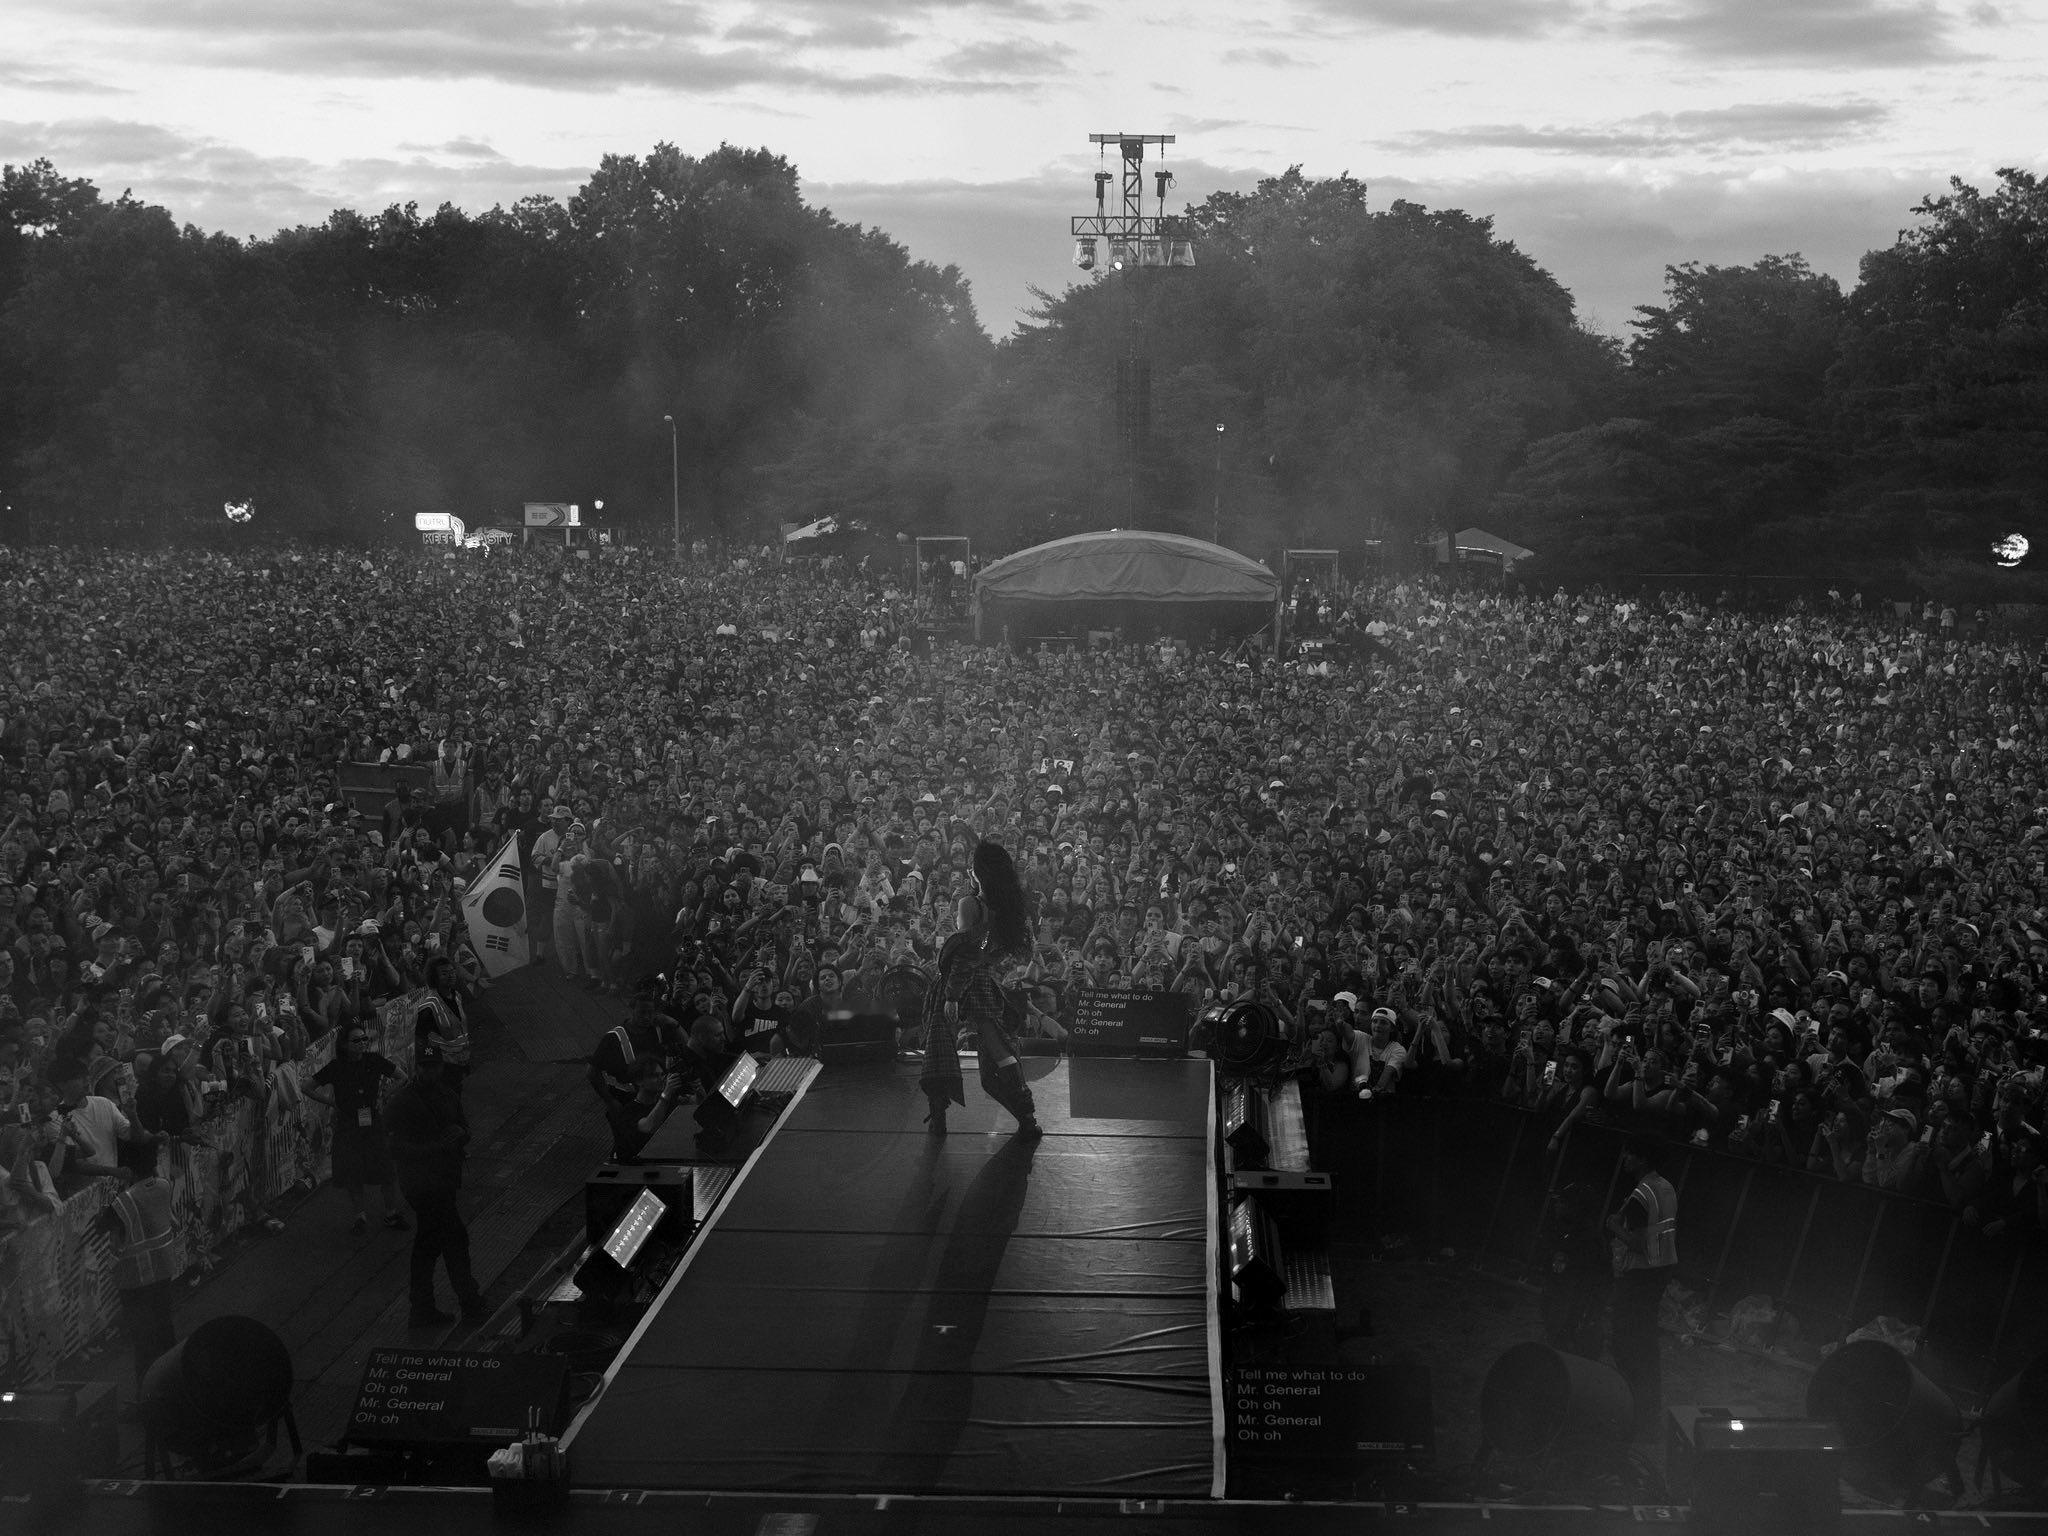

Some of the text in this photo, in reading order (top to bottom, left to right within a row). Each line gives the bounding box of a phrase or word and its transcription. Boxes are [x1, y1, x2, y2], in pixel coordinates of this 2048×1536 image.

[423, 532, 456, 544] KEEP
[1093, 1001, 1127, 1009] General
[1075, 1017, 1124, 1027] Mr. General
[375, 1353, 501, 1369] Tell me what to do
[369, 1367, 453, 1381] Mr. General
[1238, 1369, 1366, 1381] Tell me what to do
[364, 1382, 408, 1394] Oh oh
[1237, 1384, 1321, 1396] Mr. General
[359, 1397, 445, 1411] Mr. General
[1237, 1399, 1281, 1410] Oh oh
[355, 1411, 400, 1424] Oh oh
[1237, 1414, 1322, 1426] Mr. General
[1238, 1429, 1282, 1441] Oh oh
[103, 1482, 120, 1490] 3
[359, 1488, 376, 1497] 2
[620, 1493, 629, 1501] 1
[1136, 1501, 1145, 1510] 1
[1395, 1505, 1409, 1513] 2
[1655, 1509, 1671, 1518] 3
[1917, 1513, 1931, 1522] 4
